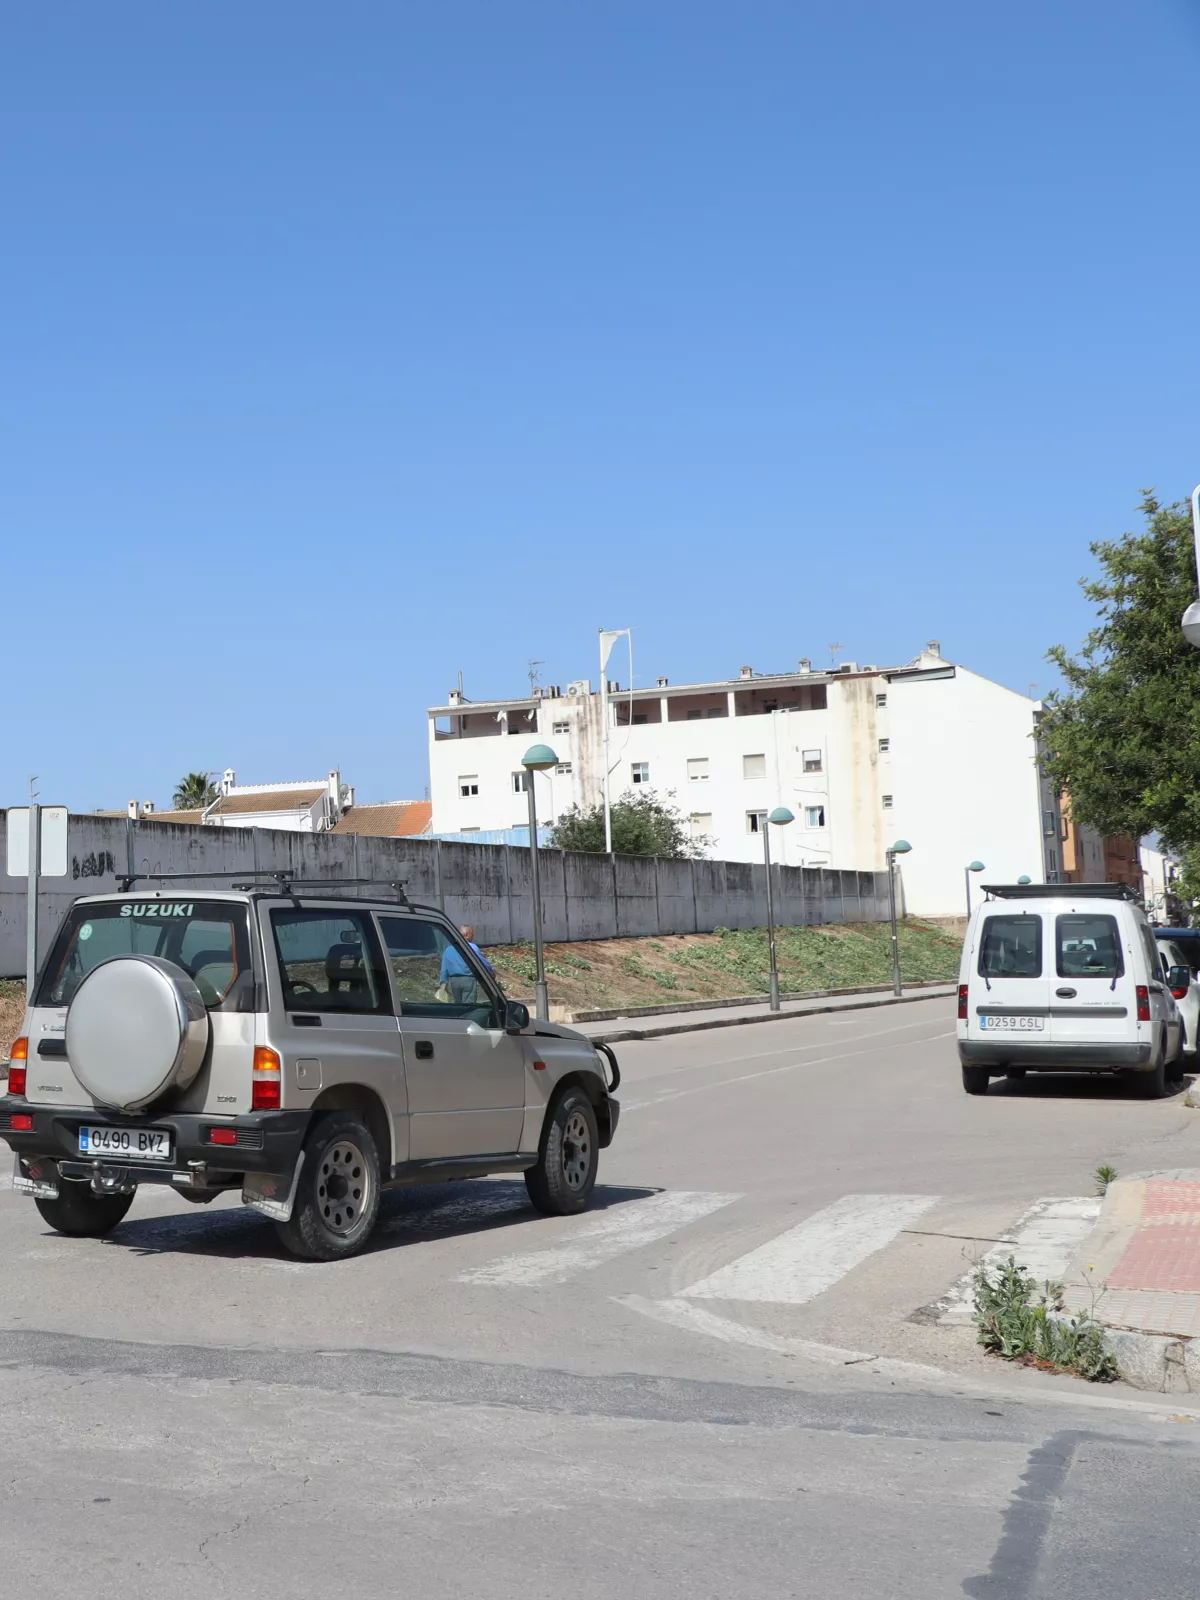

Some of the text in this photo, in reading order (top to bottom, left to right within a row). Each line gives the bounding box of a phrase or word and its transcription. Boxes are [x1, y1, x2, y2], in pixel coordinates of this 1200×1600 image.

[120, 904, 194, 917] SUZUKI
[987, 1017, 1016, 1027] 0259
[1019, 1017, 1041, 1028] CSL
[91, 1130, 164, 1153] 0490 BYZ
